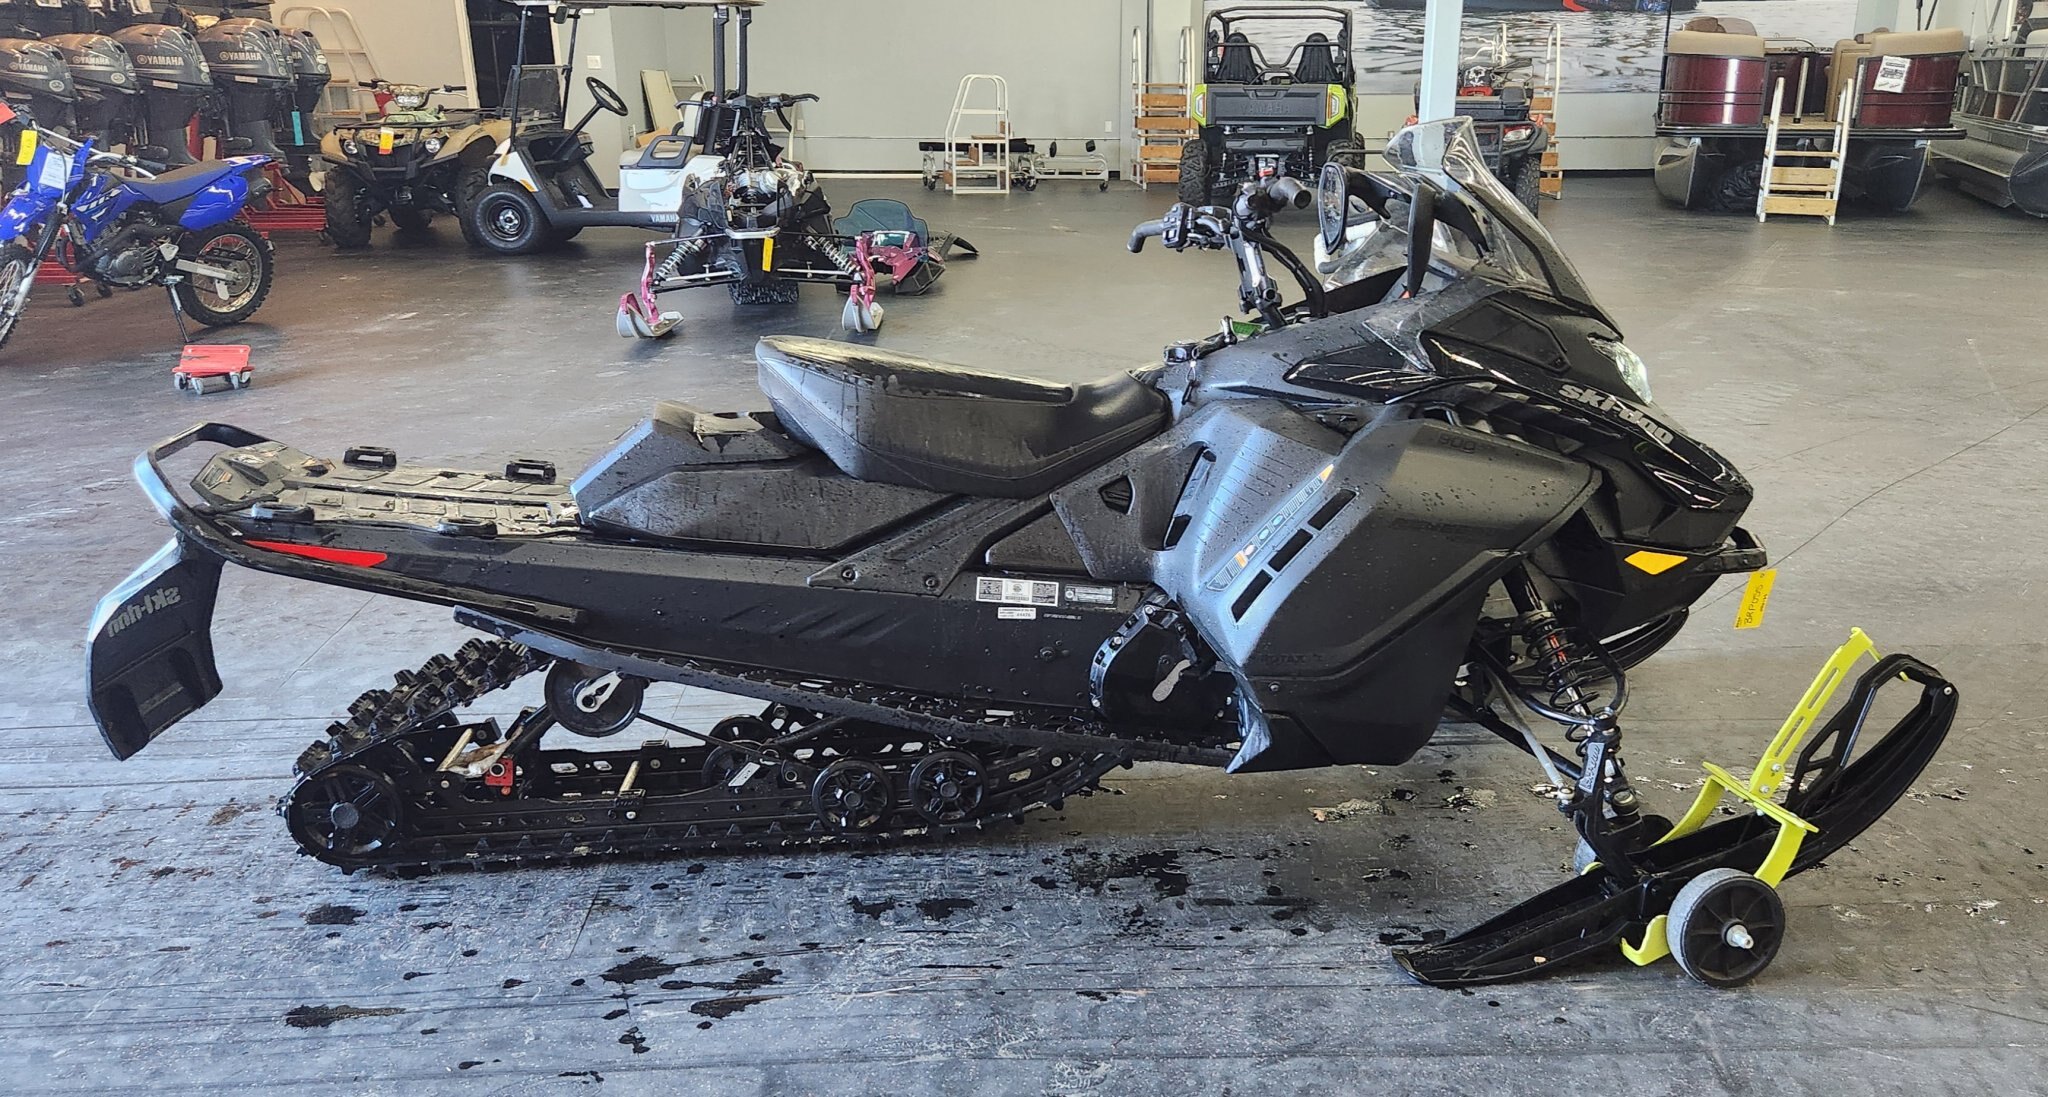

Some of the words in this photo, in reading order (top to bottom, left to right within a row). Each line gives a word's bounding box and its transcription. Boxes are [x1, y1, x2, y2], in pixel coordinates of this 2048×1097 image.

[80, 56, 110, 65] YAMAHA
[147, 55, 184, 66] YAMAHA
[229, 51, 262, 61] YAMAHA
[18, 63, 48, 73] YAMAHA
